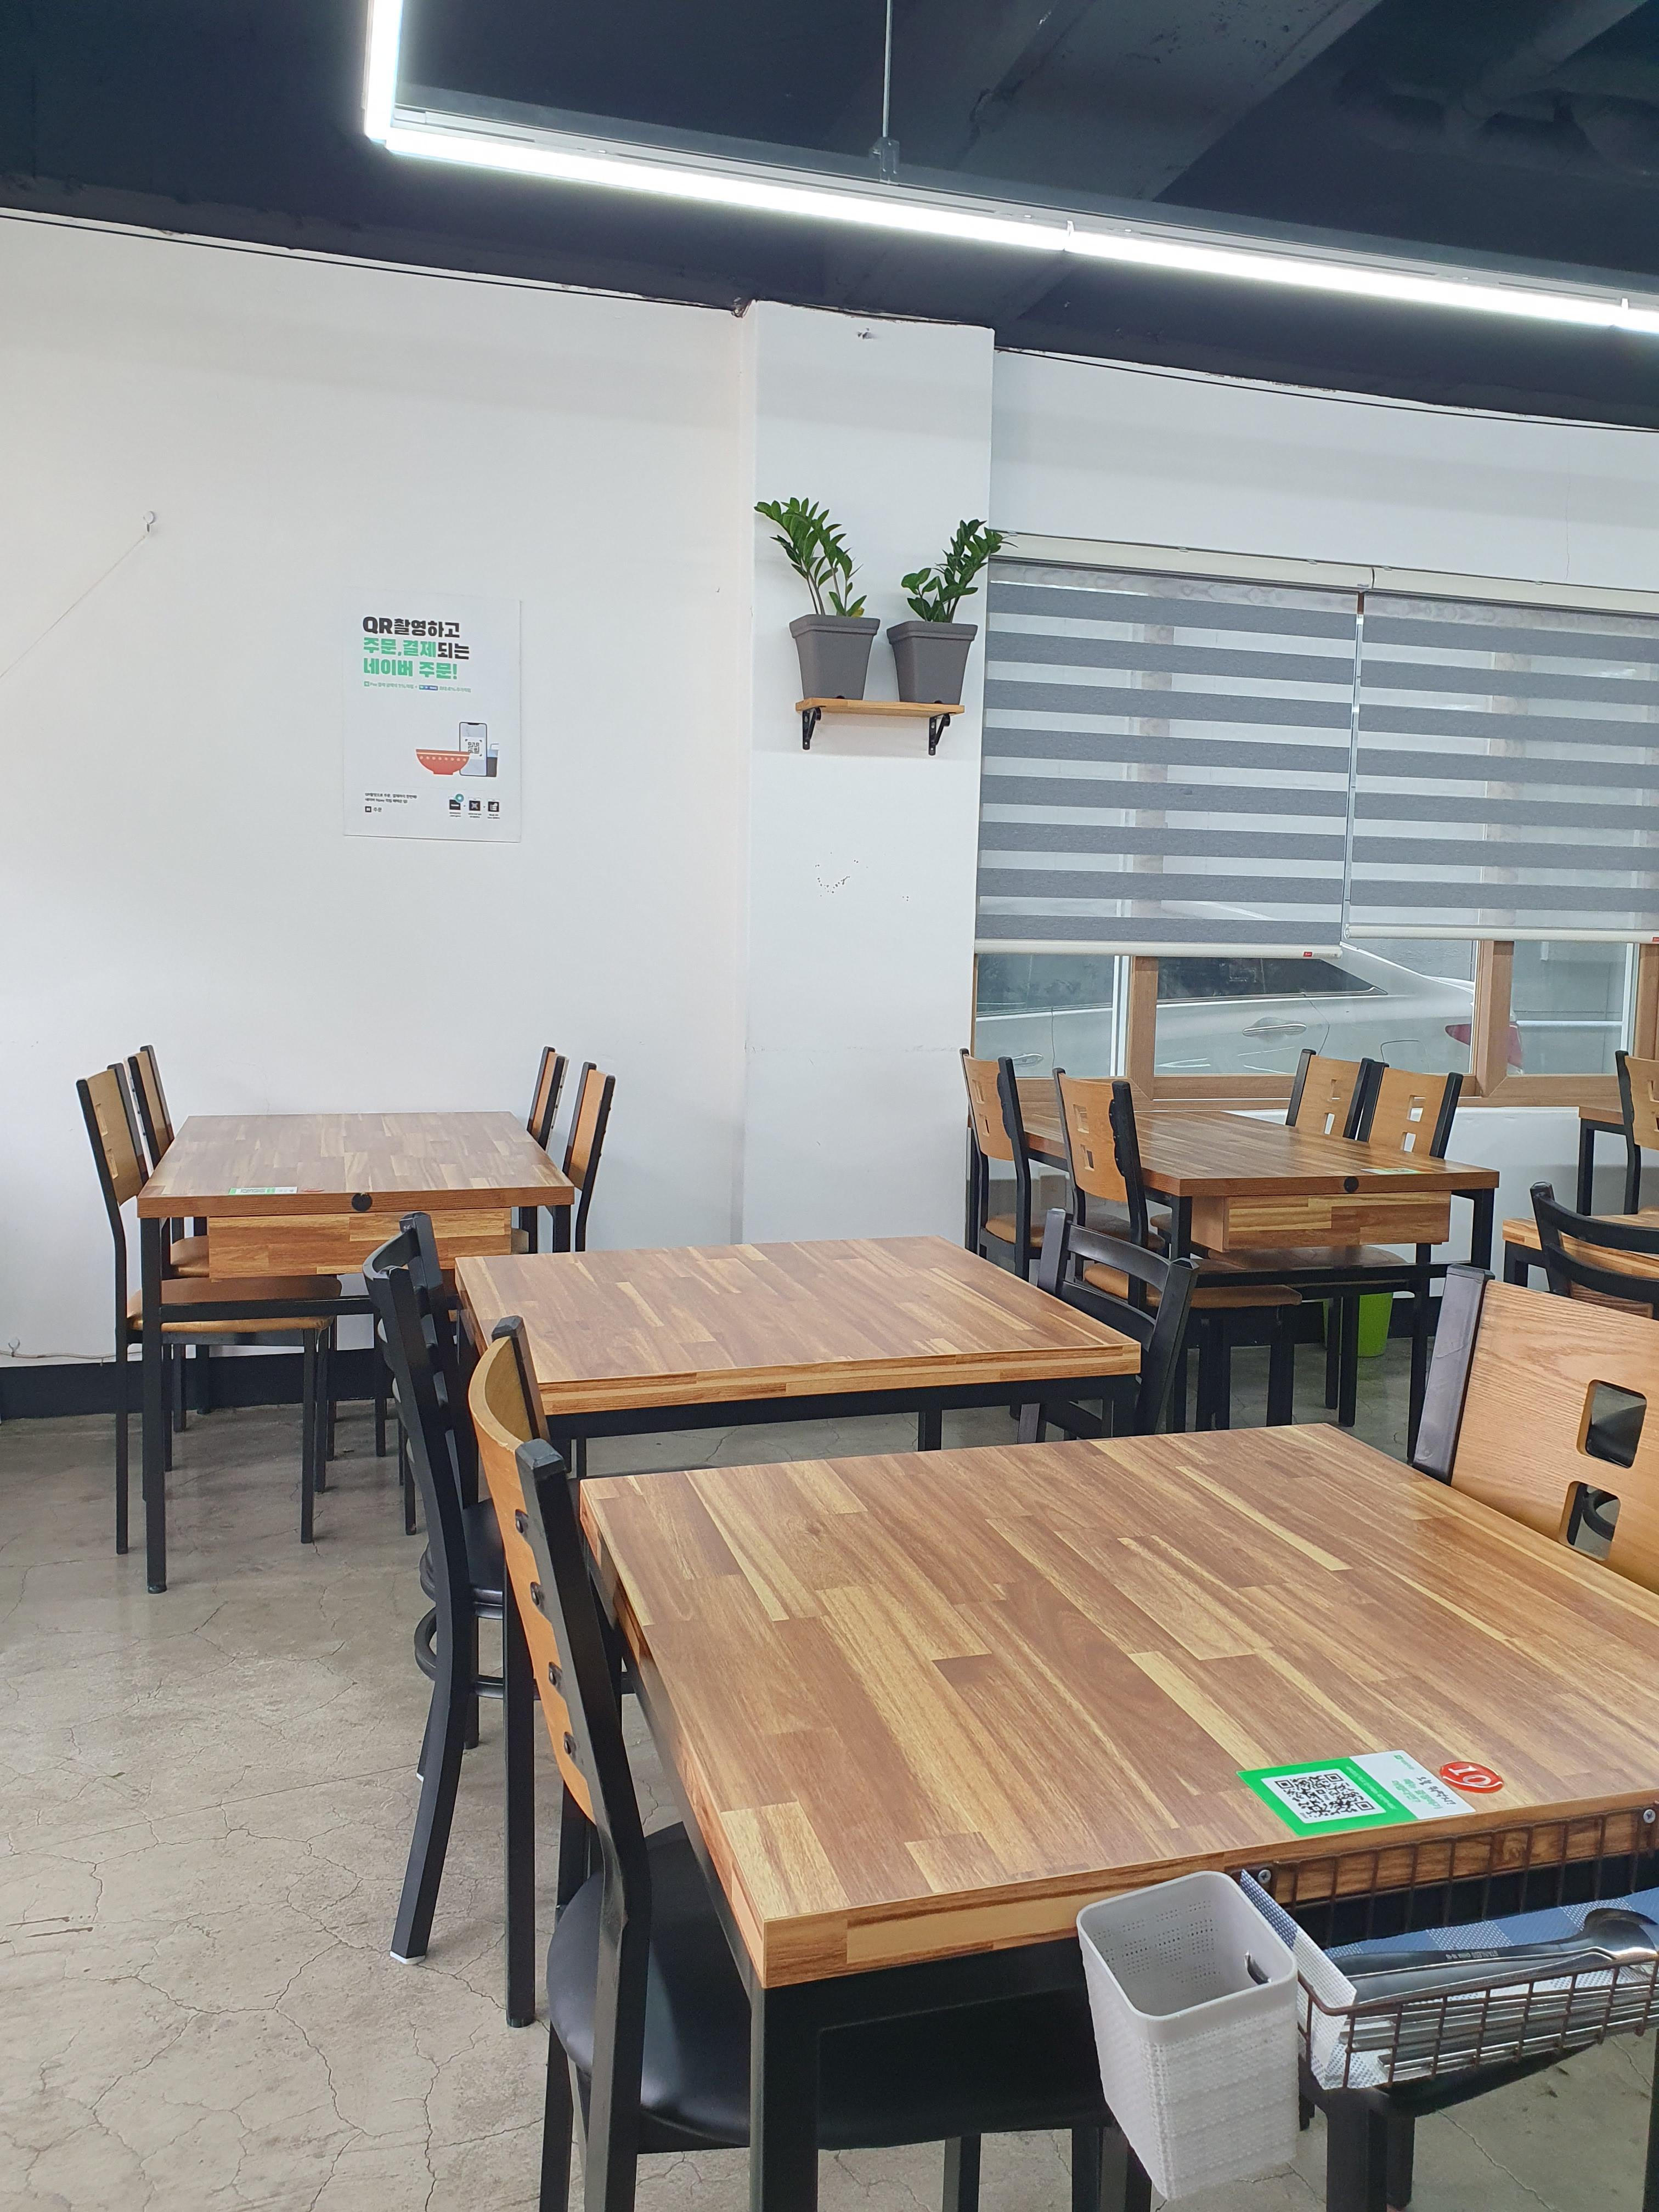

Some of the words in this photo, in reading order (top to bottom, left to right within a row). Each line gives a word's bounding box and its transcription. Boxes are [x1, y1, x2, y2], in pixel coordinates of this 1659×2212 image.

[363, 617, 460, 637] QR촬영하고
[363, 637, 469, 659] 주문,결제되는
[364, 658, 413, 676] 네이버
[419, 662, 457, 679] 주문!
